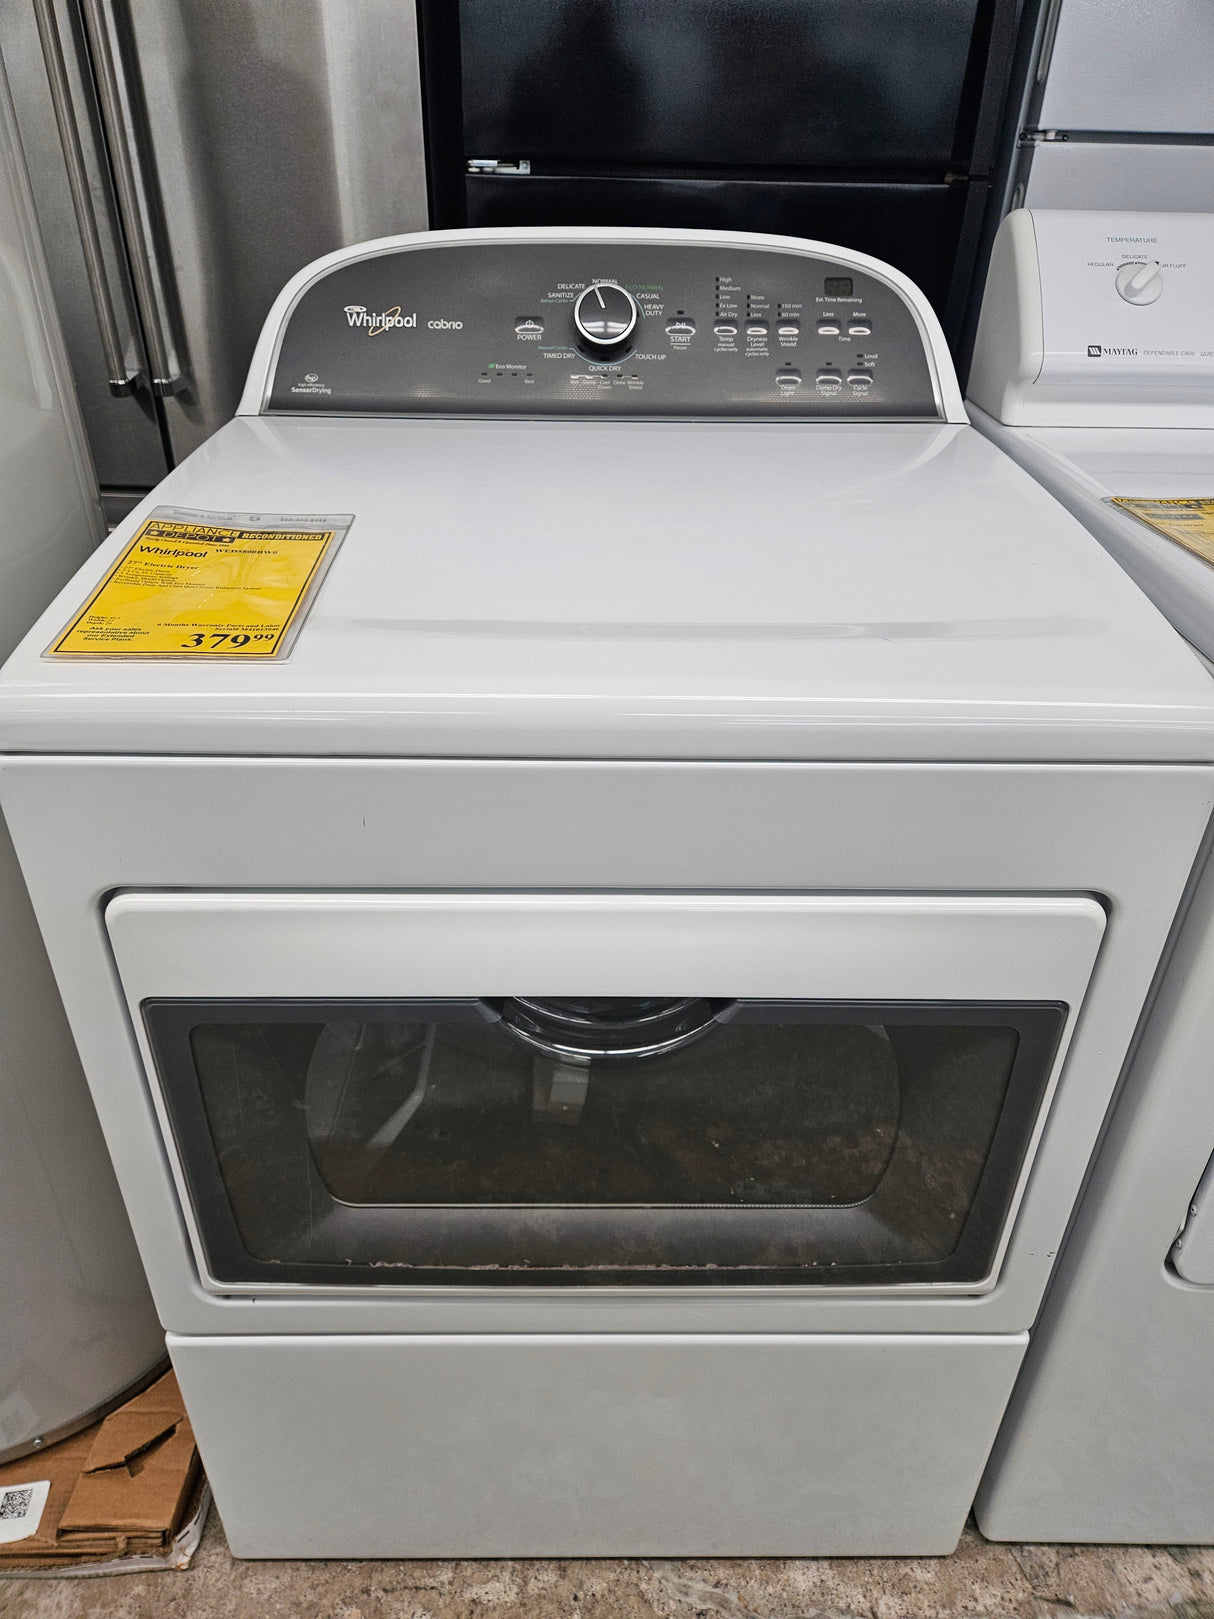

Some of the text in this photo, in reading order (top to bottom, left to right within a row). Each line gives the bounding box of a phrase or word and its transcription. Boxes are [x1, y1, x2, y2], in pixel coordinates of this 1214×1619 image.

[346, 312, 463, 331] Whirlpool cabrio
[291, 386, 331, 394] SensorDrying
[150, 522, 238, 537] APPLIANCE
[163, 530, 217, 542] DEPOT
[139, 545, 208, 560] Whirlpool
